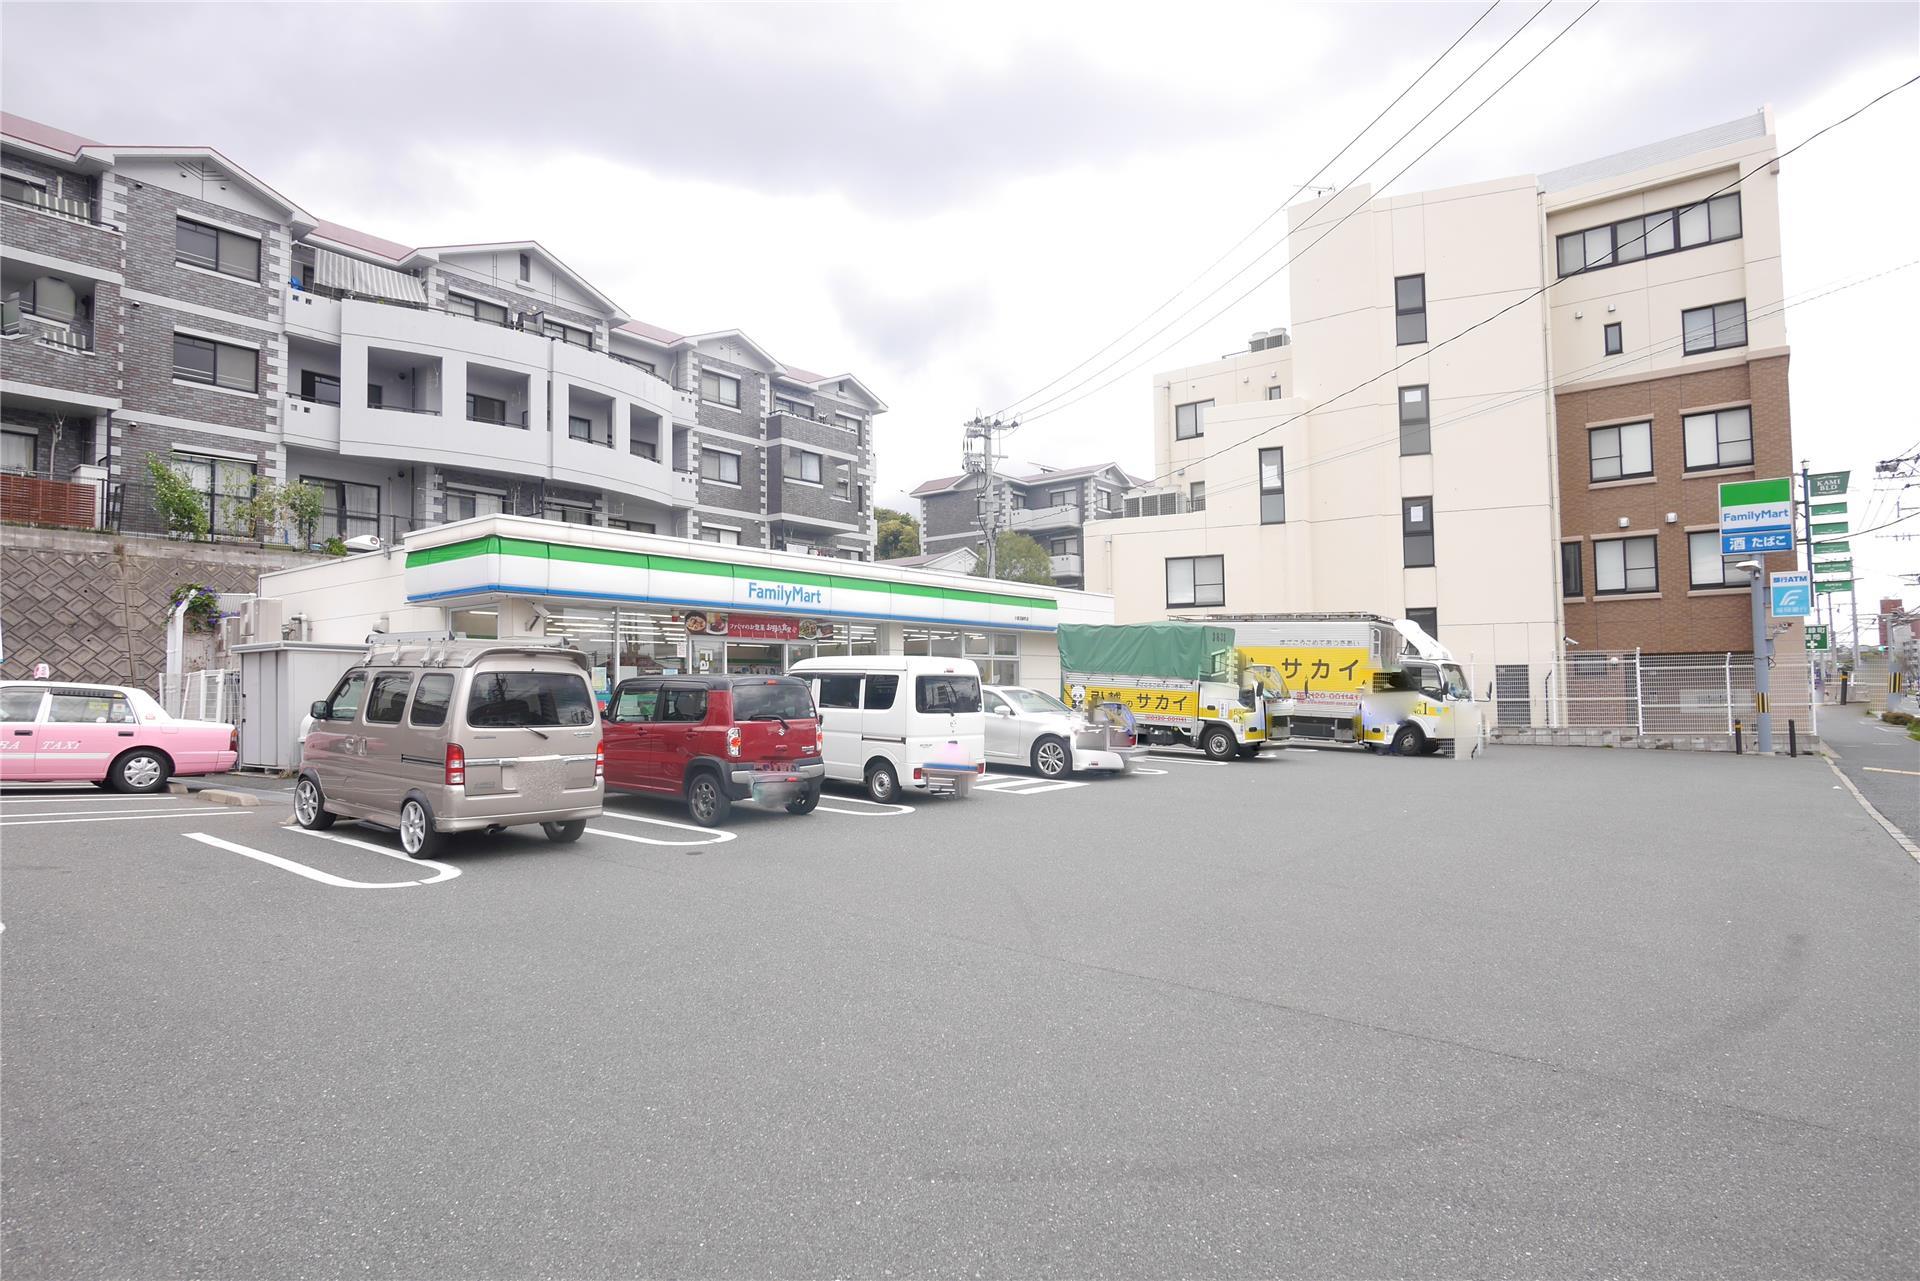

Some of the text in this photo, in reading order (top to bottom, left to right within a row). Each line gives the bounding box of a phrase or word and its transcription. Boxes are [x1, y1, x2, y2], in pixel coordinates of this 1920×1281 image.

[1817, 479, 1841, 487] KAMI
[1723, 509, 1789, 522] FamilyMart
[1729, 535, 1787, 551] 酒 たばこ
[748, 582, 822, 606] FamilyMart
[1281, 657, 1359, 681] サカイ
